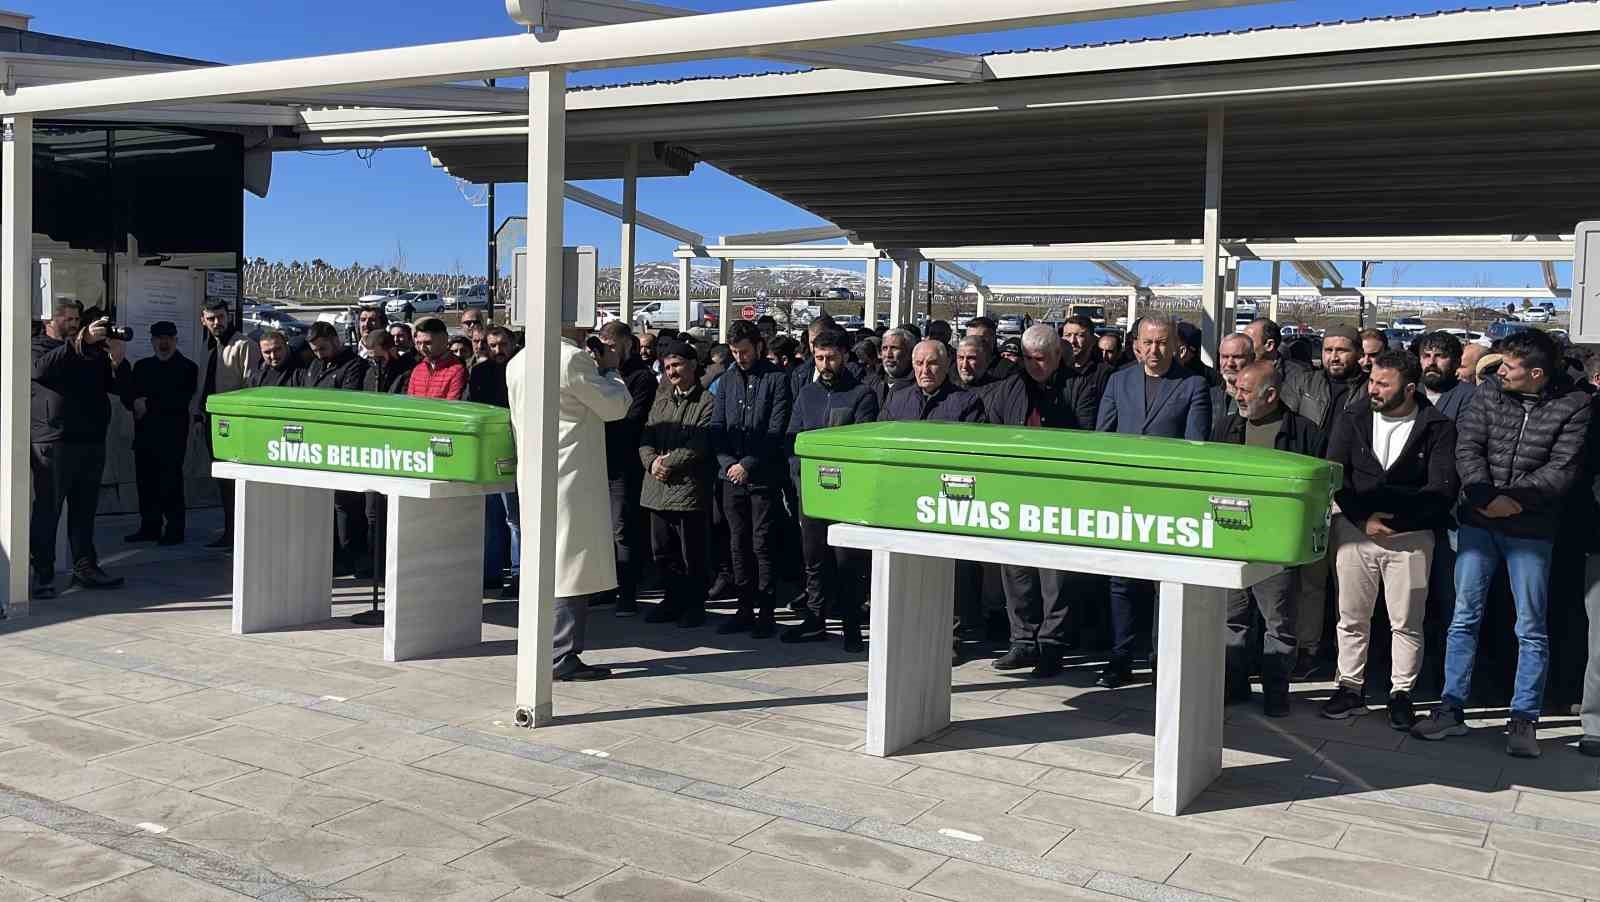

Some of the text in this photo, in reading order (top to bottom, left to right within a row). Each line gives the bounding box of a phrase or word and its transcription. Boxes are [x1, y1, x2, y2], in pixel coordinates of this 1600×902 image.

[267, 437, 434, 473] SİVAS BELEDİYESİ
[916, 491, 1214, 549] SİVAS BELEDİYESİ
